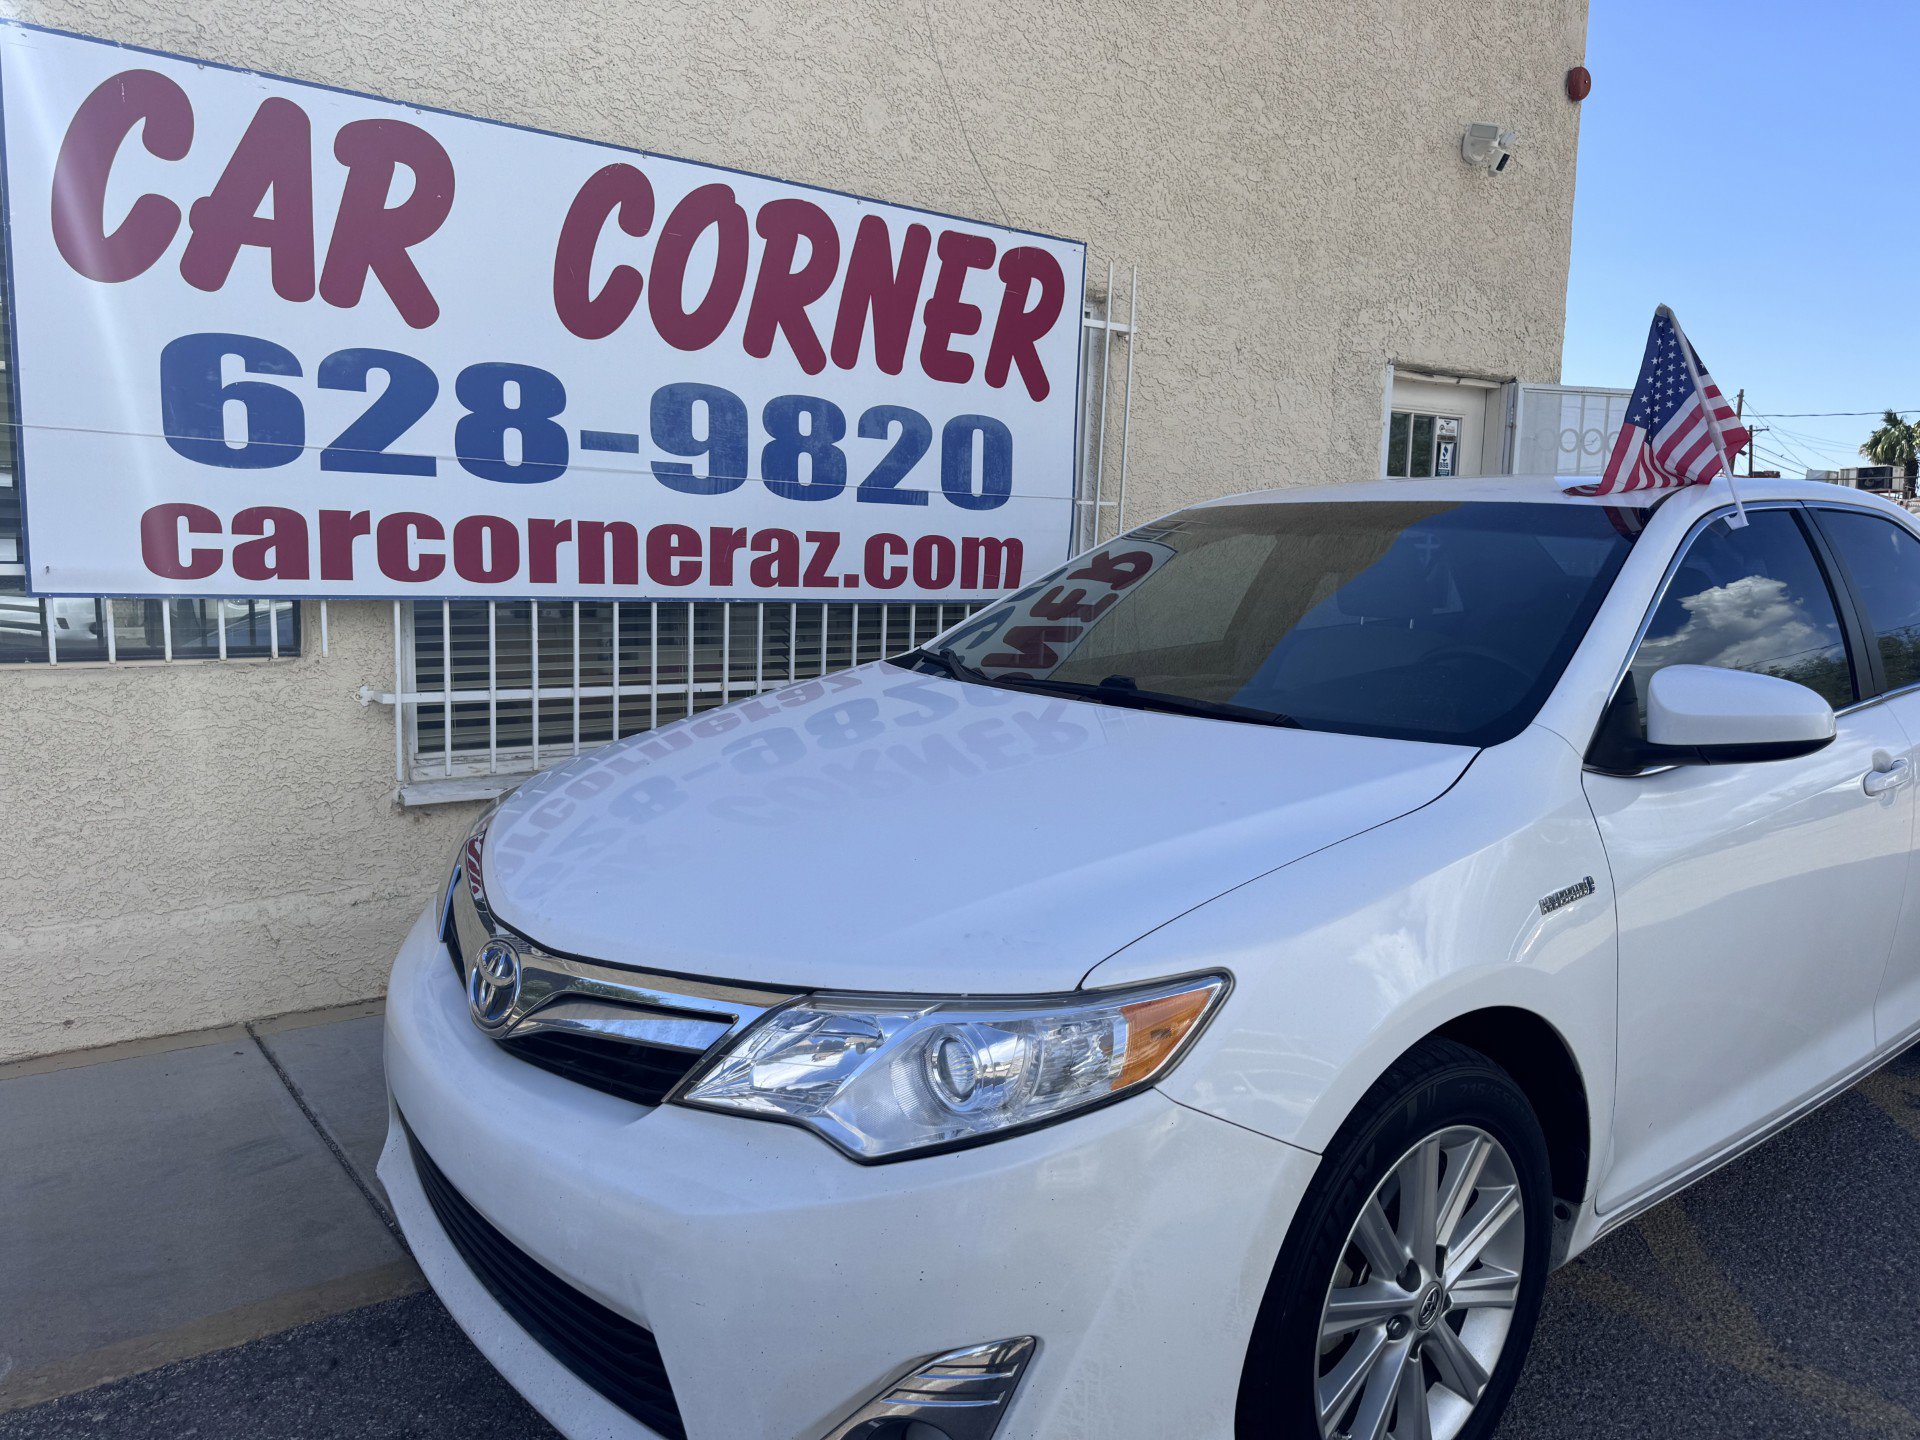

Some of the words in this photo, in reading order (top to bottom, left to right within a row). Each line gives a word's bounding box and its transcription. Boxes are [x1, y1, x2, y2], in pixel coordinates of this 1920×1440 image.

[51, 68, 456, 330] CAR
[553, 162, 1066, 403] CORNER
[160, 332, 1013, 511] 628-9820
[140, 502, 1024, 591] carcorneraz.com
